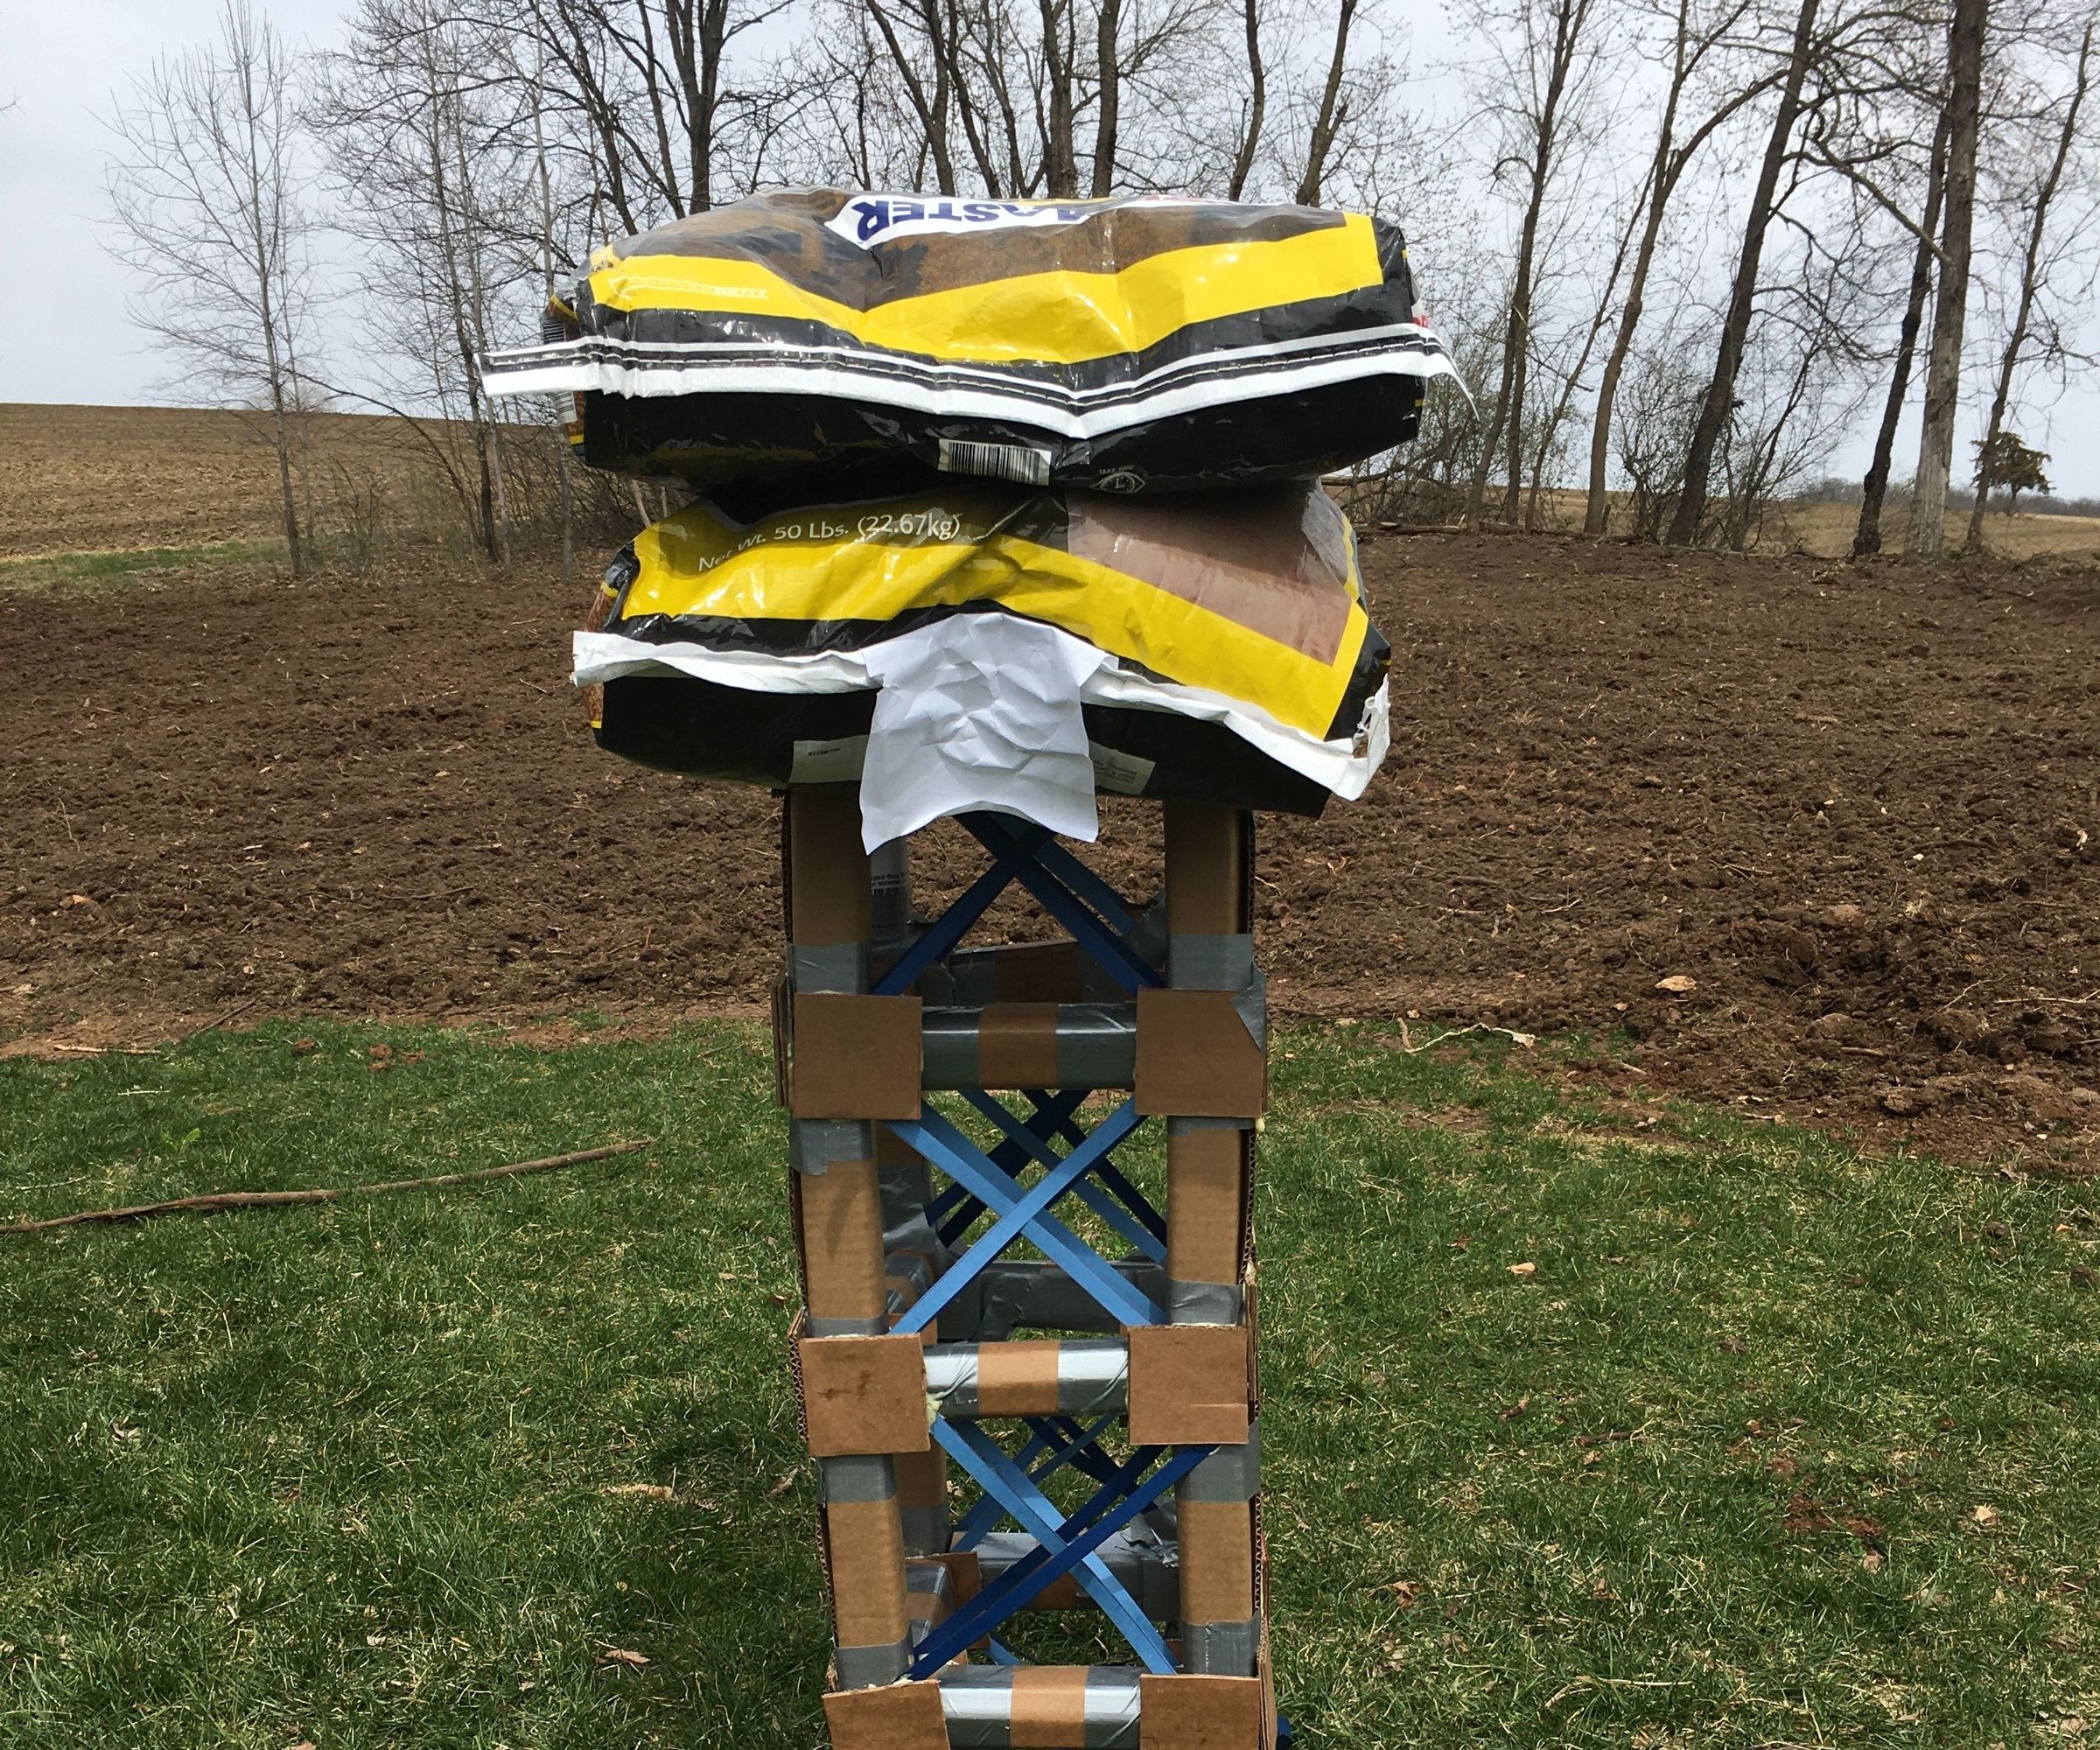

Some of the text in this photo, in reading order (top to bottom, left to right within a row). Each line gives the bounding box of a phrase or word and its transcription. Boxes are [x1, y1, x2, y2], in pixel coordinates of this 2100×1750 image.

[738, 534, 766, 551] Wt.
[774, 525, 802, 540] 50
[808, 522, 850, 539] Lbs.
[857, 512, 962, 541] (22.67kg)
